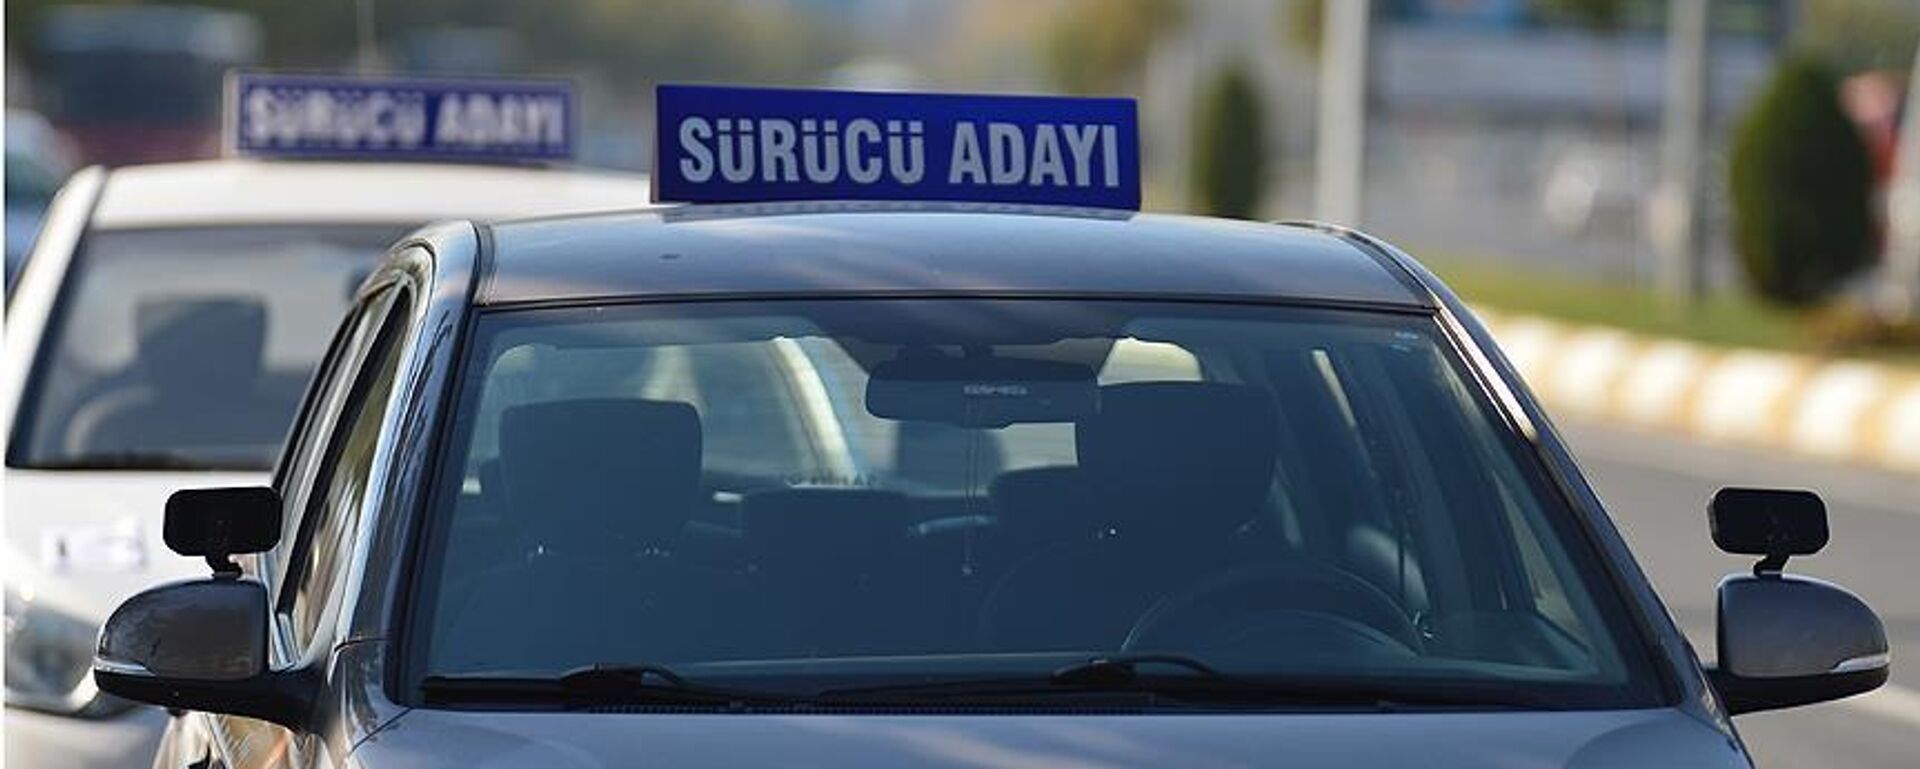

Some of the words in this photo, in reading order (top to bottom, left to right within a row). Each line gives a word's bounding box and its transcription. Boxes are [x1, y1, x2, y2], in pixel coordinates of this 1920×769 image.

[249, 88, 427, 148] SÜRÜCÜ
[436, 92, 564, 144] ADAYI
[679, 116, 925, 184] SÜRÜCÜ
[948, 121, 1120, 187] ADAYI
